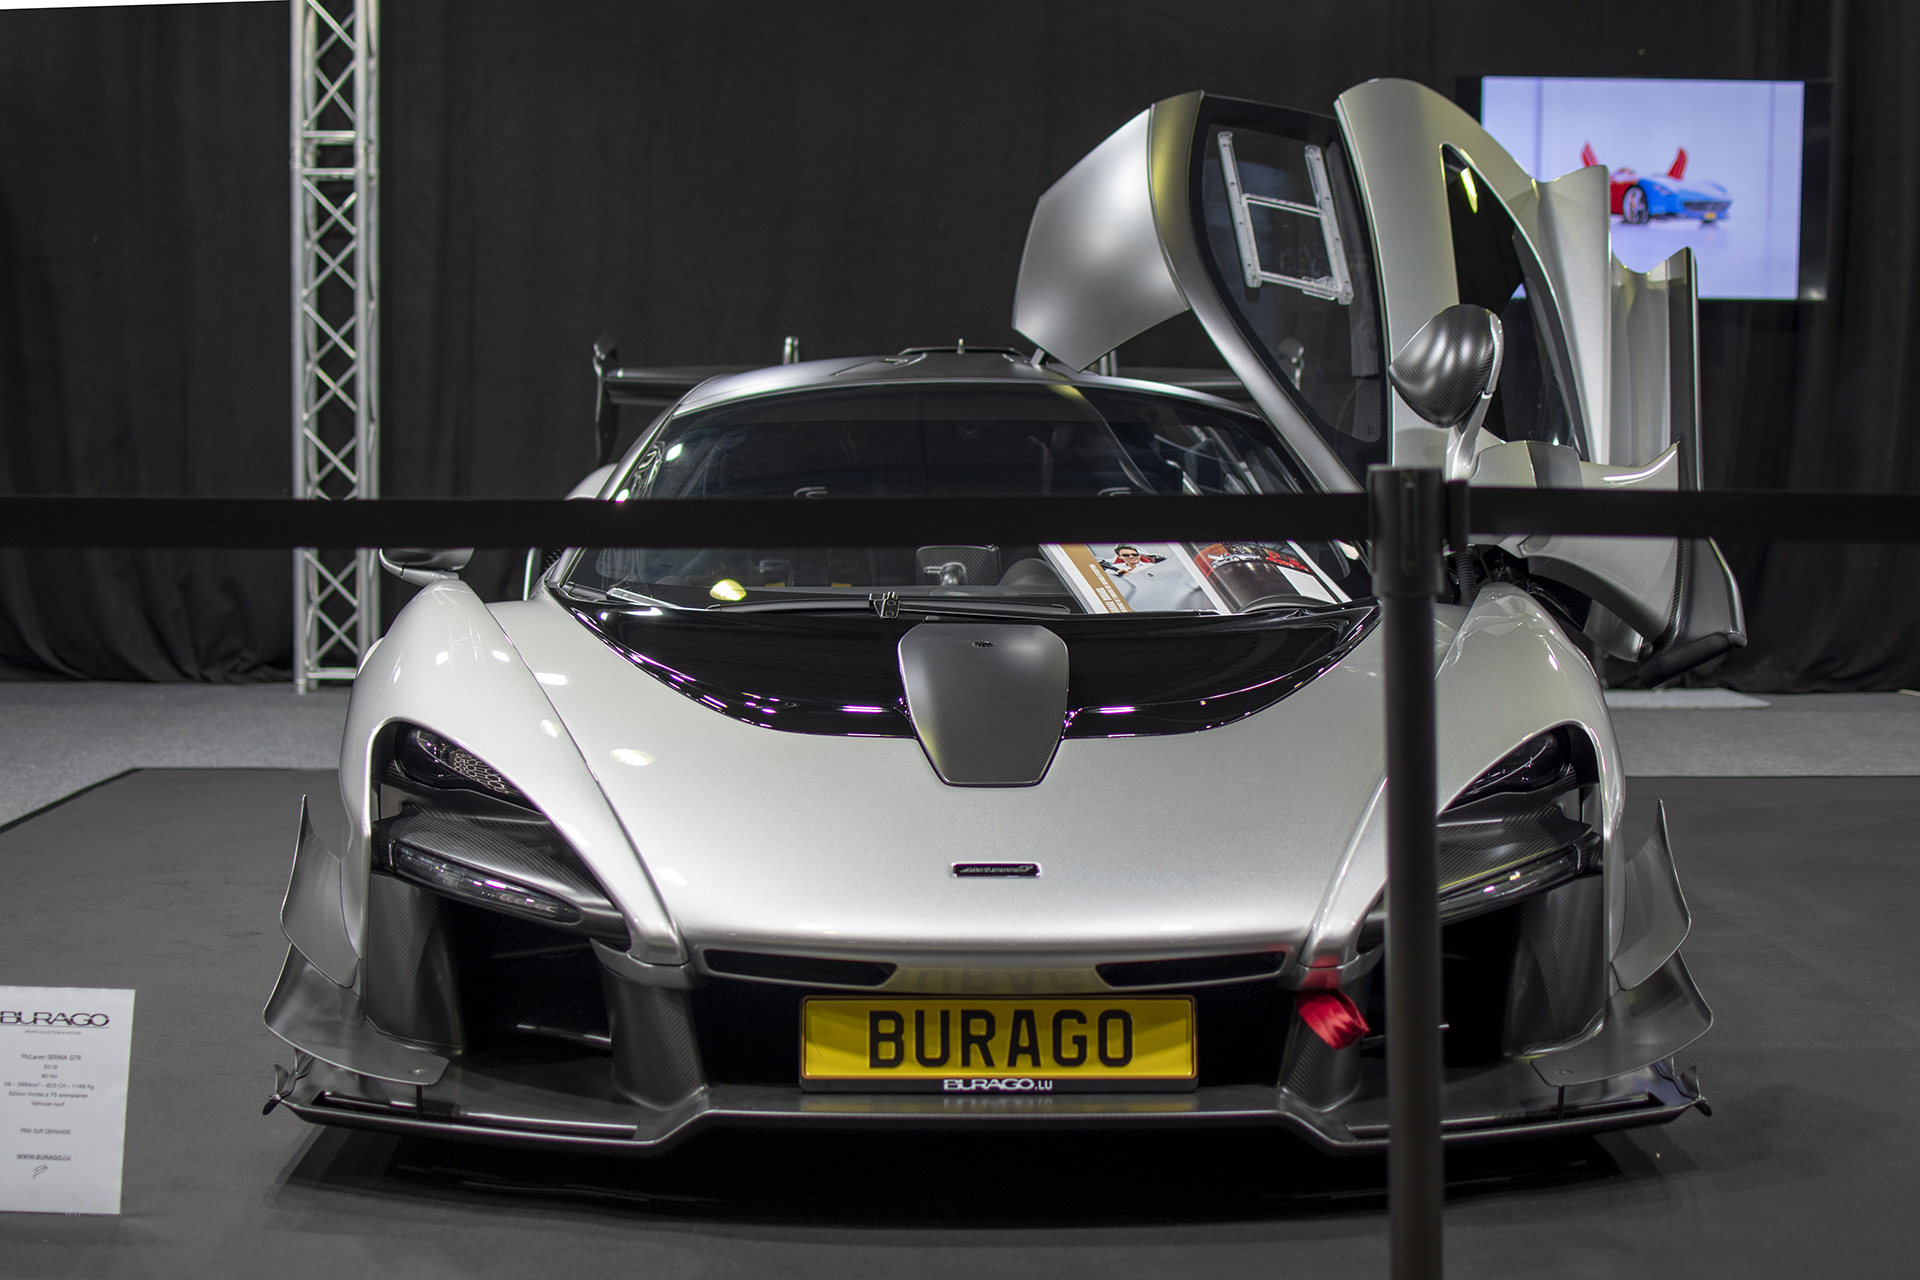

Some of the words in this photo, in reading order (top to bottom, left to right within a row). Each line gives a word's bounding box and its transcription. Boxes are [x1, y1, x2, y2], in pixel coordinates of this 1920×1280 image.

[0, 1011, 110, 1027] BURAGO
[868, 1008, 1133, 1069] BURAGO
[943, 1078, 1053, 1091] BURAGO.LU
